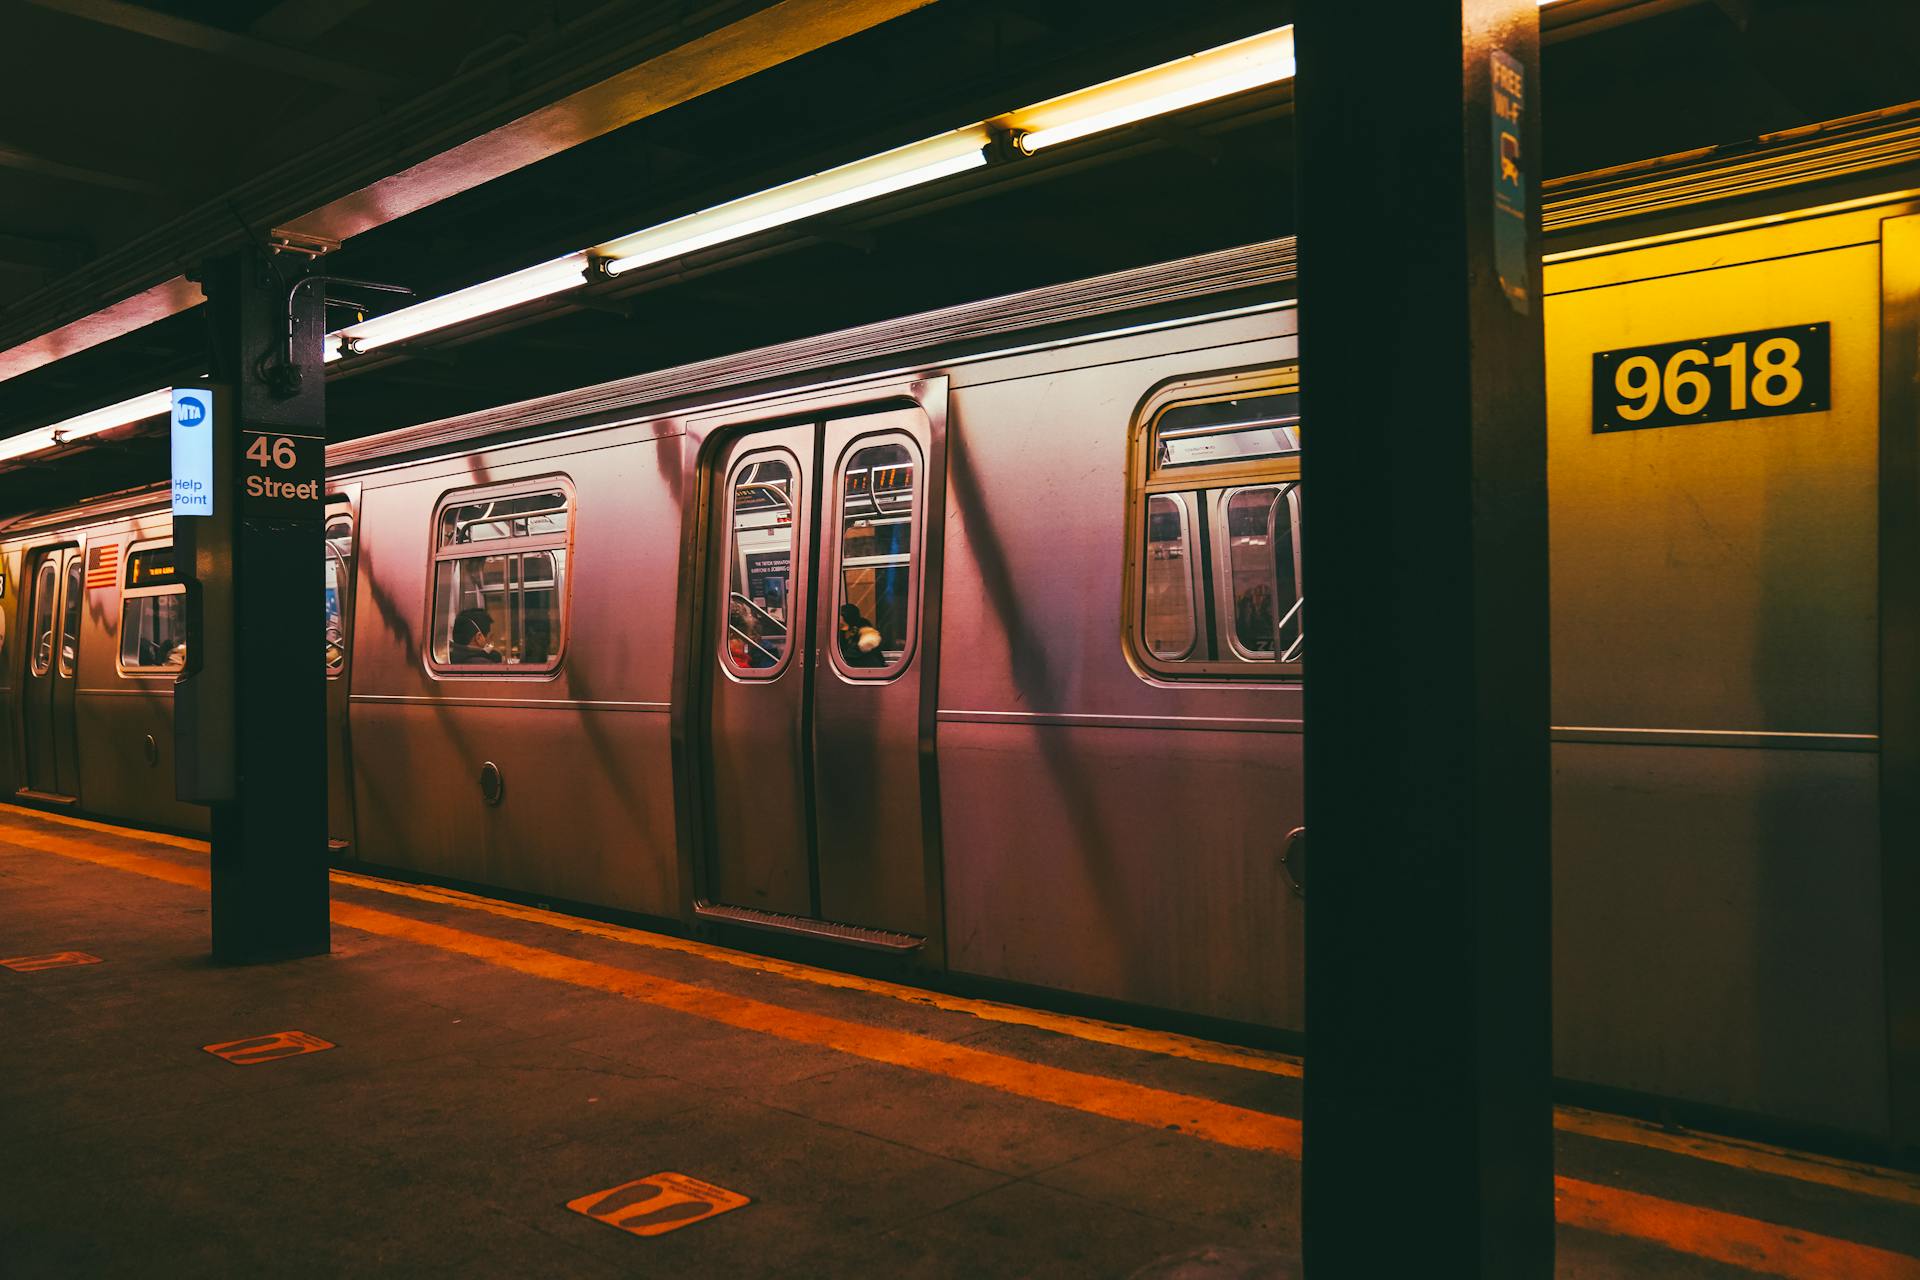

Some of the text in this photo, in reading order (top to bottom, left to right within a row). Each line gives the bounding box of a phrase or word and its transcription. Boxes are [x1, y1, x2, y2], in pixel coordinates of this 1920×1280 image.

[1491, 56, 1522, 99] FREE
[1614, 337, 1803, 421] 9618
[177, 403, 201, 421] MTA
[246, 436, 297, 470] 46
[174, 480, 203, 492] Help
[246, 475, 319, 500] Street
[174, 494, 207, 505] Point
